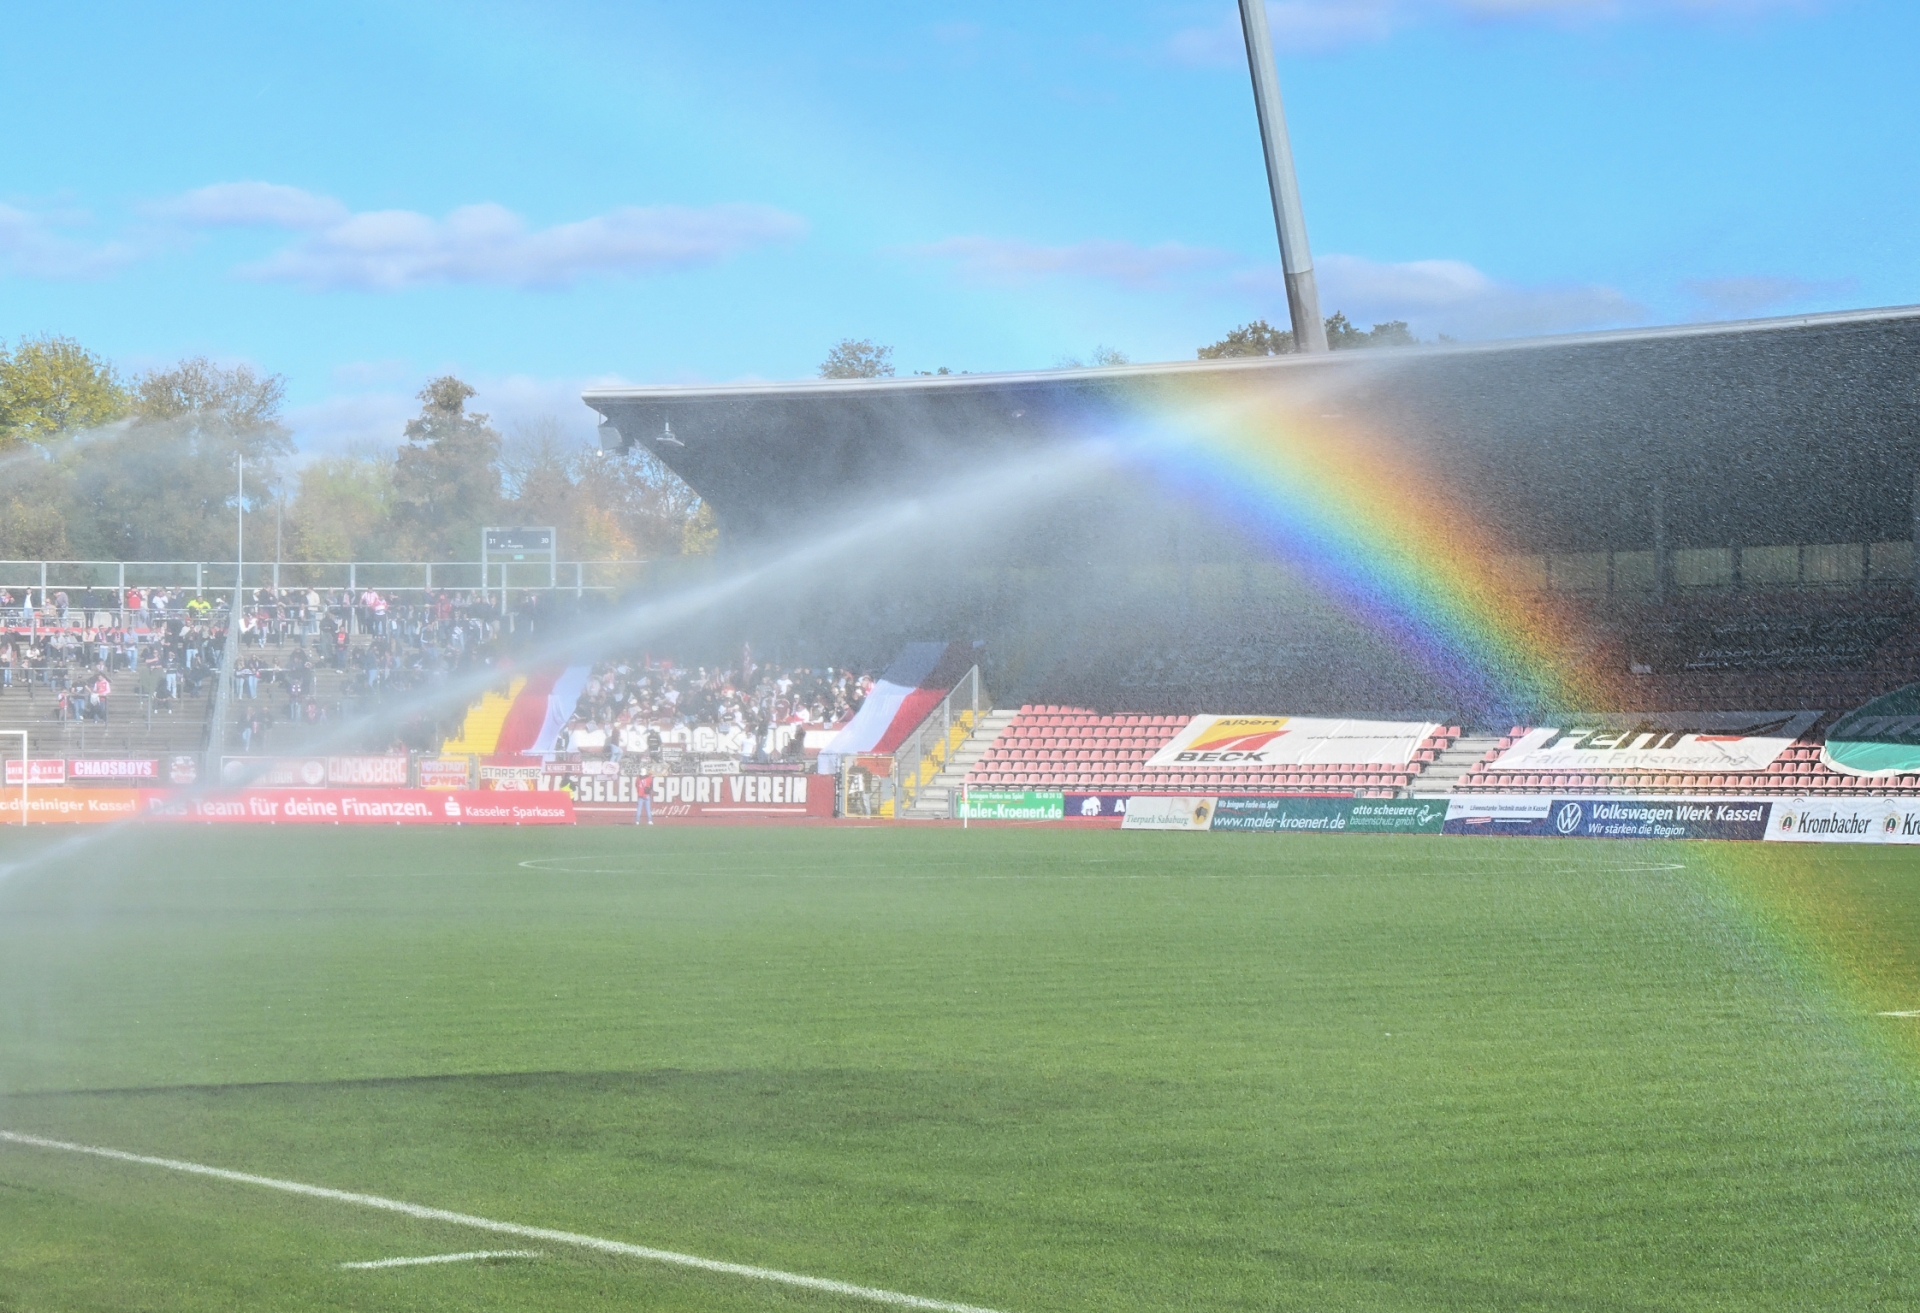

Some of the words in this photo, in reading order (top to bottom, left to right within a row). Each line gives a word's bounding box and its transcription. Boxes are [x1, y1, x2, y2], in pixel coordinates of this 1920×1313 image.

[1173, 752, 1270, 762] BECK
[1521, 752, 1568, 764] Fair
[1576, 752, 1598, 764] in
[74, 761, 152, 775] CHAOSBOYS
[421, 761, 466, 772] VORSTADT
[652, 775, 724, 803] SPORT
[729, 775, 808, 803] VEREIN
[88, 799, 136, 811] Kassel
[191, 798, 246, 816] Team
[249, 796, 279, 816] für
[284, 797, 338, 816] deine
[341, 797, 433, 817] Finanzen.
[960, 803, 1063, 819] Maler-Kroenert.de
[1352, 805, 1372, 815] otto
[1373, 804, 1419, 815] scheuerer
[465, 806, 511, 817] Kasseler
[512, 806, 566, 819] Sparkasse
[1592, 804, 1674, 824] Volkswagen
[1676, 805, 1713, 821] Werk
[1716, 805, 1764, 821] Kassel
[1126, 814, 1155, 825] Tierpark
[1156, 815, 1189, 826] Sababurg
[1213, 812, 1346, 829] www.maler-kroenert.de
[1349, 816, 1394, 826] bautenschutz
[1394, 816, 1415, 828] gmbh
[1797, 811, 1872, 834] Krombacher
[1588, 823, 1604, 833] Wir
[1605, 823, 1637, 834] stärken
[1639, 824, 1652, 835] die
[1653, 824, 1685, 838] Region
